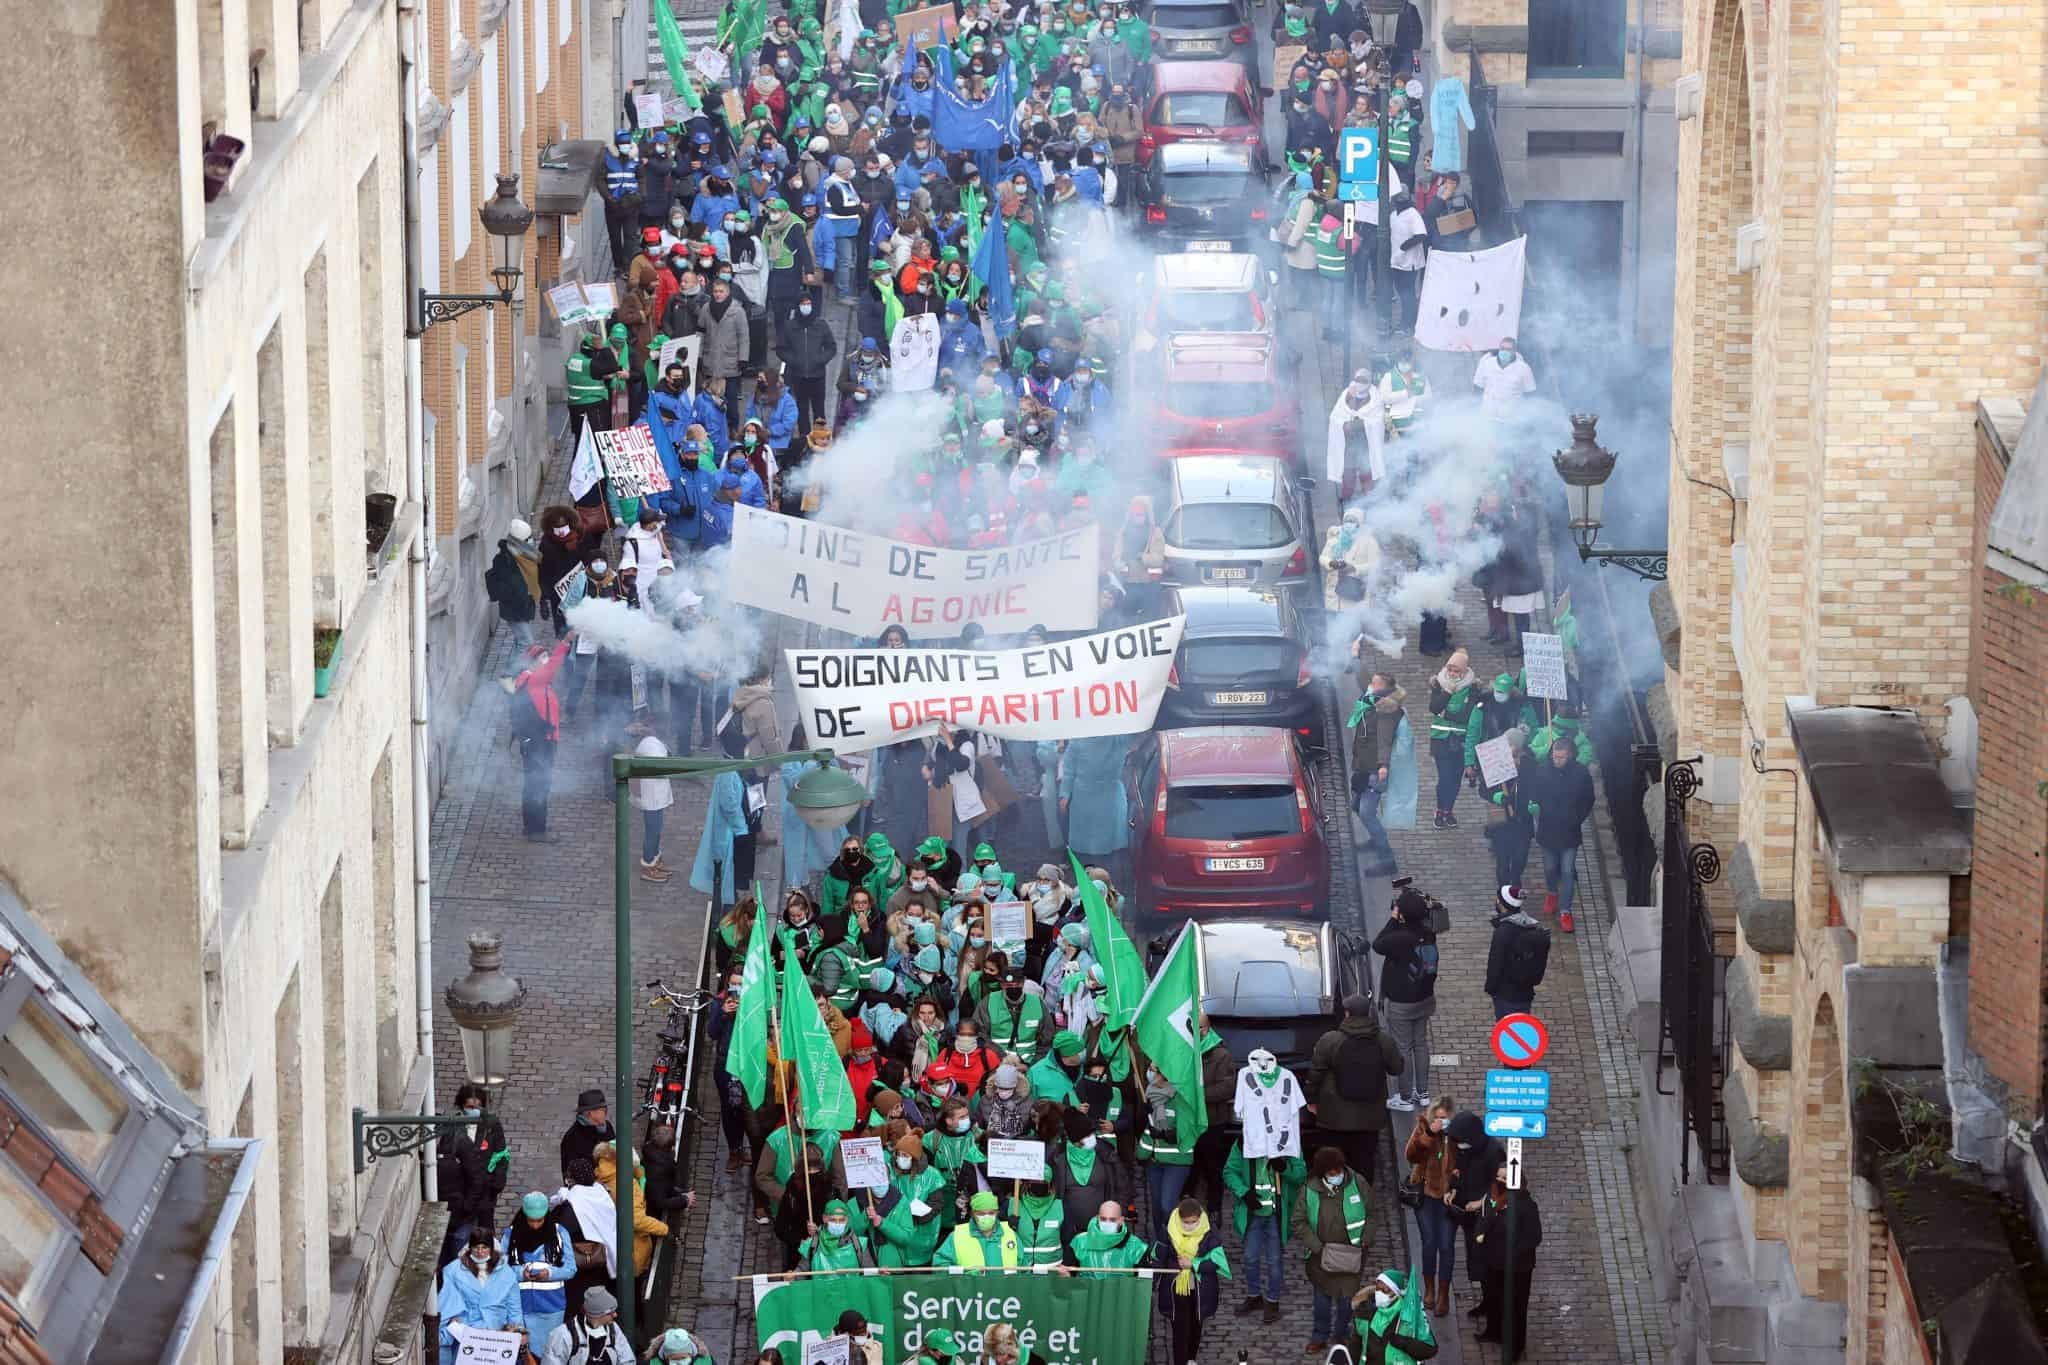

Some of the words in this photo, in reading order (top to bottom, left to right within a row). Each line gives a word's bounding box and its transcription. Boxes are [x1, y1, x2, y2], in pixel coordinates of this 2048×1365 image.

[1346, 136, 1373, 174] P
[749, 511, 862, 568] OINS
[889, 545, 937, 581] DE
[965, 532, 1081, 581] SANTE
[790, 572, 809, 603] A
[831, 582, 851, 615] L
[881, 584, 1027, 624] AGONIE
[796, 655, 999, 688] SOIGNANTS
[1022, 646, 1074, 679] EN
[1087, 623, 1172, 665] VOIE
[814, 706, 866, 738] DE
[889, 680, 1138, 732] DISPARITION
[903, 1291, 1021, 1321] Service
[1048, 1325, 1081, 1354] et
